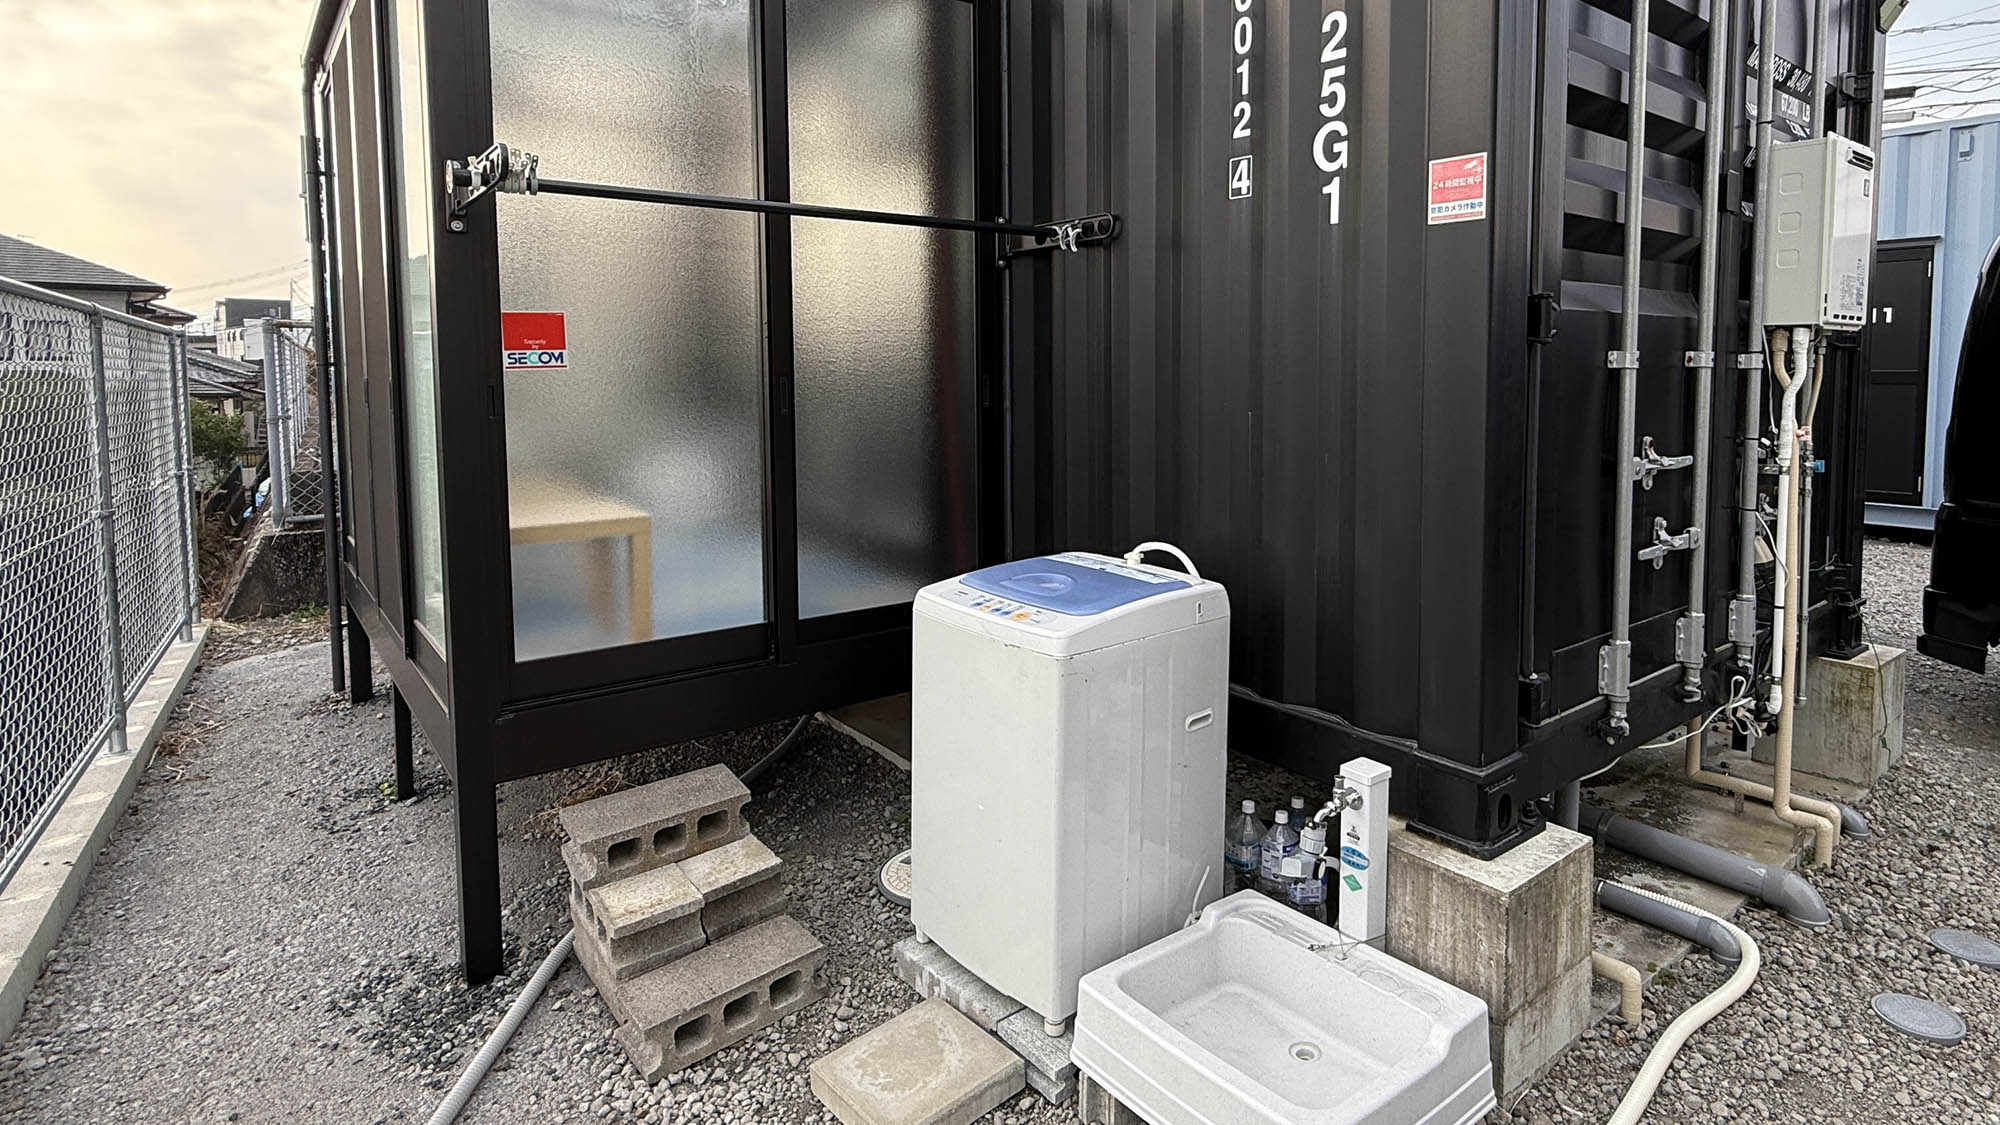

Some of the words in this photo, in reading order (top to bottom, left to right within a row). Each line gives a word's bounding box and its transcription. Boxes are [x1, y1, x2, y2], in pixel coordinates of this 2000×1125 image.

[1312, 10, 1349, 225] 25G1
[1231, 159, 1250, 195] 4
[507, 351, 564, 365] SECOM
